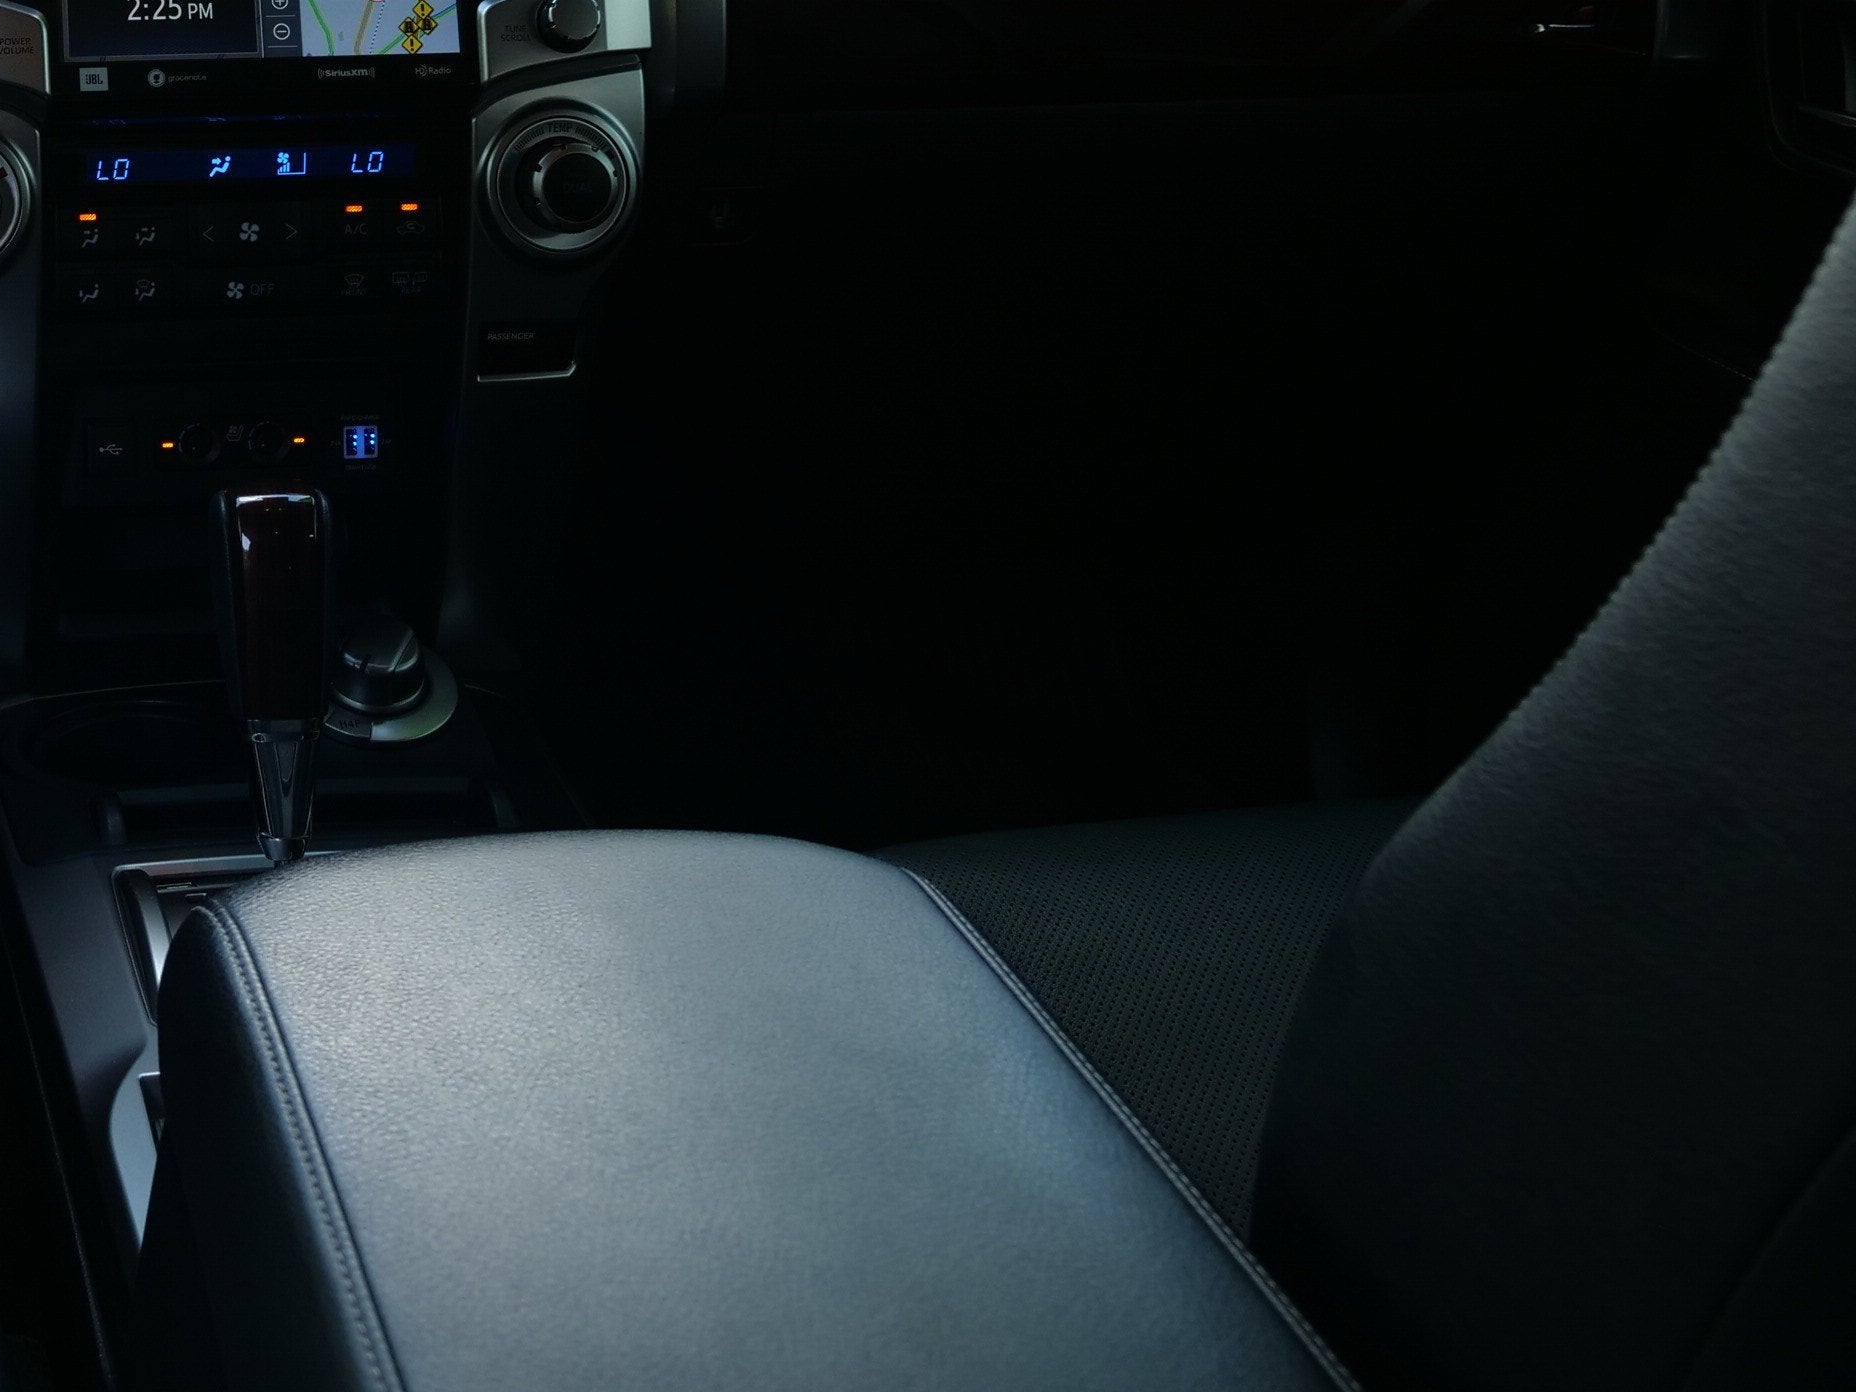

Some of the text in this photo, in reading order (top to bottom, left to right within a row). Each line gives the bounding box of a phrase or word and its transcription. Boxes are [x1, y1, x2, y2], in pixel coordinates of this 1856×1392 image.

[187, 2, 213, 20] PM
[504, 24, 528, 33] TUNE
[0, 37, 32, 46] POWER
[500, 33, 532, 42] SCROLL
[428, 66, 452, 74] Radio
[85, 74, 207, 85] JBL gracenote
[547, 122, 573, 133] TEMP
[350, 150, 385, 174] LO
[95, 158, 131, 181] LO
[344, 223, 368, 235] A/C
[250, 282, 275, 296] OFF
[487, 331, 535, 341] PASSENGER
